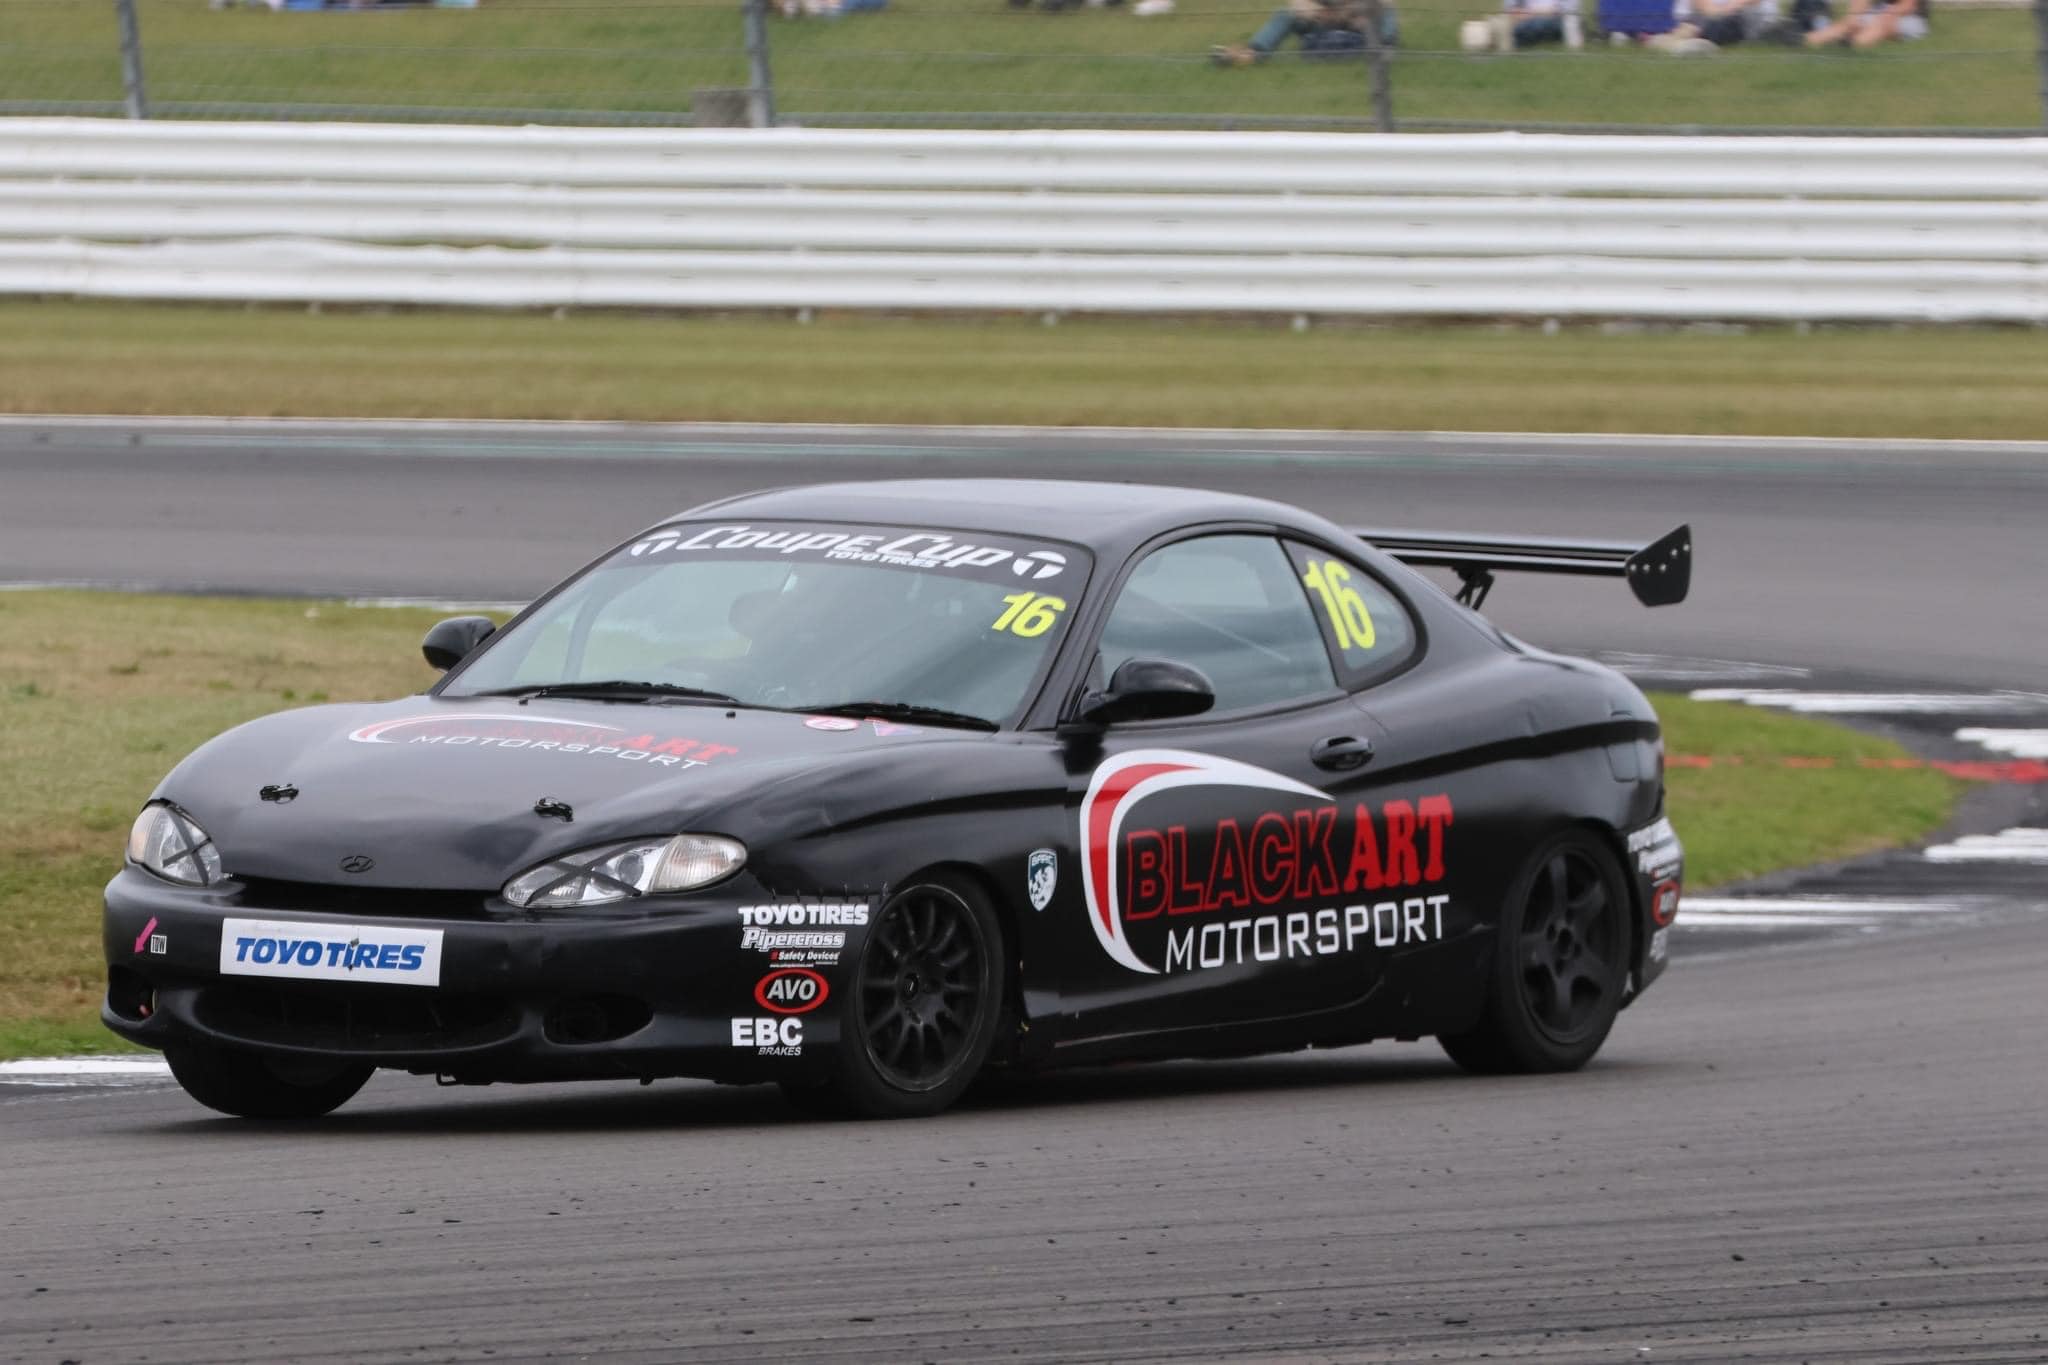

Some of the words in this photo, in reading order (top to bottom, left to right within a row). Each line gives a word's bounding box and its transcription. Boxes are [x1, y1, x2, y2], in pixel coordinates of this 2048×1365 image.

[676, 526, 885, 554] Coupe
[876, 534, 1013, 567] Cup
[824, 550, 880, 562] TOYO
[879, 554, 939, 568] TIRES
[992, 592, 1066, 637] 16
[1303, 560, 1376, 649] 16
[408, 735, 708, 769] MOTORSPORT
[1126, 806, 1338, 920] BLACK
[1343, 793, 1454, 890] ART
[738, 904, 805, 925] TOYO
[807, 904, 869, 925] TIRES
[741, 927, 846, 952] Pipercross
[1165, 894, 1450, 974] MOTORSPORT
[236, 937, 323, 966] TOYO
[326, 944, 425, 970] TIRES
[778, 950, 806, 961] Safety
[767, 978, 816, 1000] AVO
[731, 1018, 803, 1046] EBC
[758, 1047, 801, 1056] BRAKES
